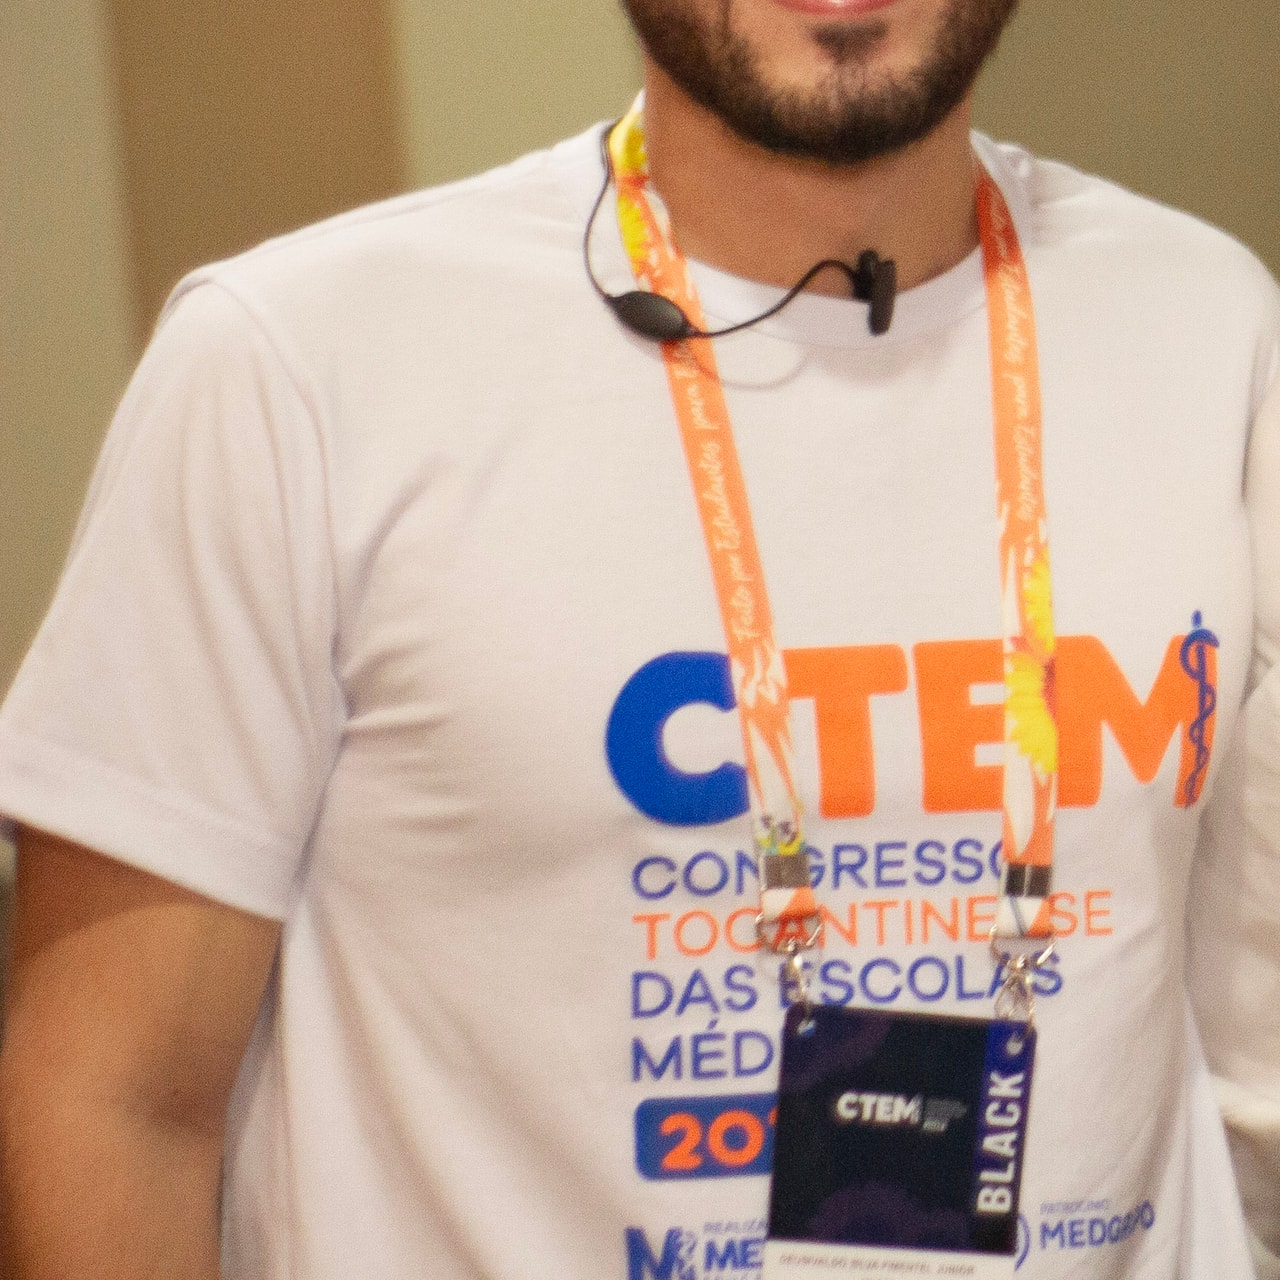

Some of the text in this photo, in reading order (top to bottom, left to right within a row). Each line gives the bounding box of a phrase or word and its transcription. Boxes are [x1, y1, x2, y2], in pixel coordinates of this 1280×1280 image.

[684, 383, 720, 430] para
[1004, 373, 1031, 419] para
[698, 441, 740, 551] Estudantes
[604, 634, 1218, 827] CTEM
[631, 838, 1003, 900] CONGRESS
[631, 890, 1113, 961] TOCANTINESE
[631, 964, 758, 1019] DAS
[659, 1105, 779, 1171] 20
[836, 1091, 923, 1124] CTEM
[976, 1071, 1024, 1214] BLACK
